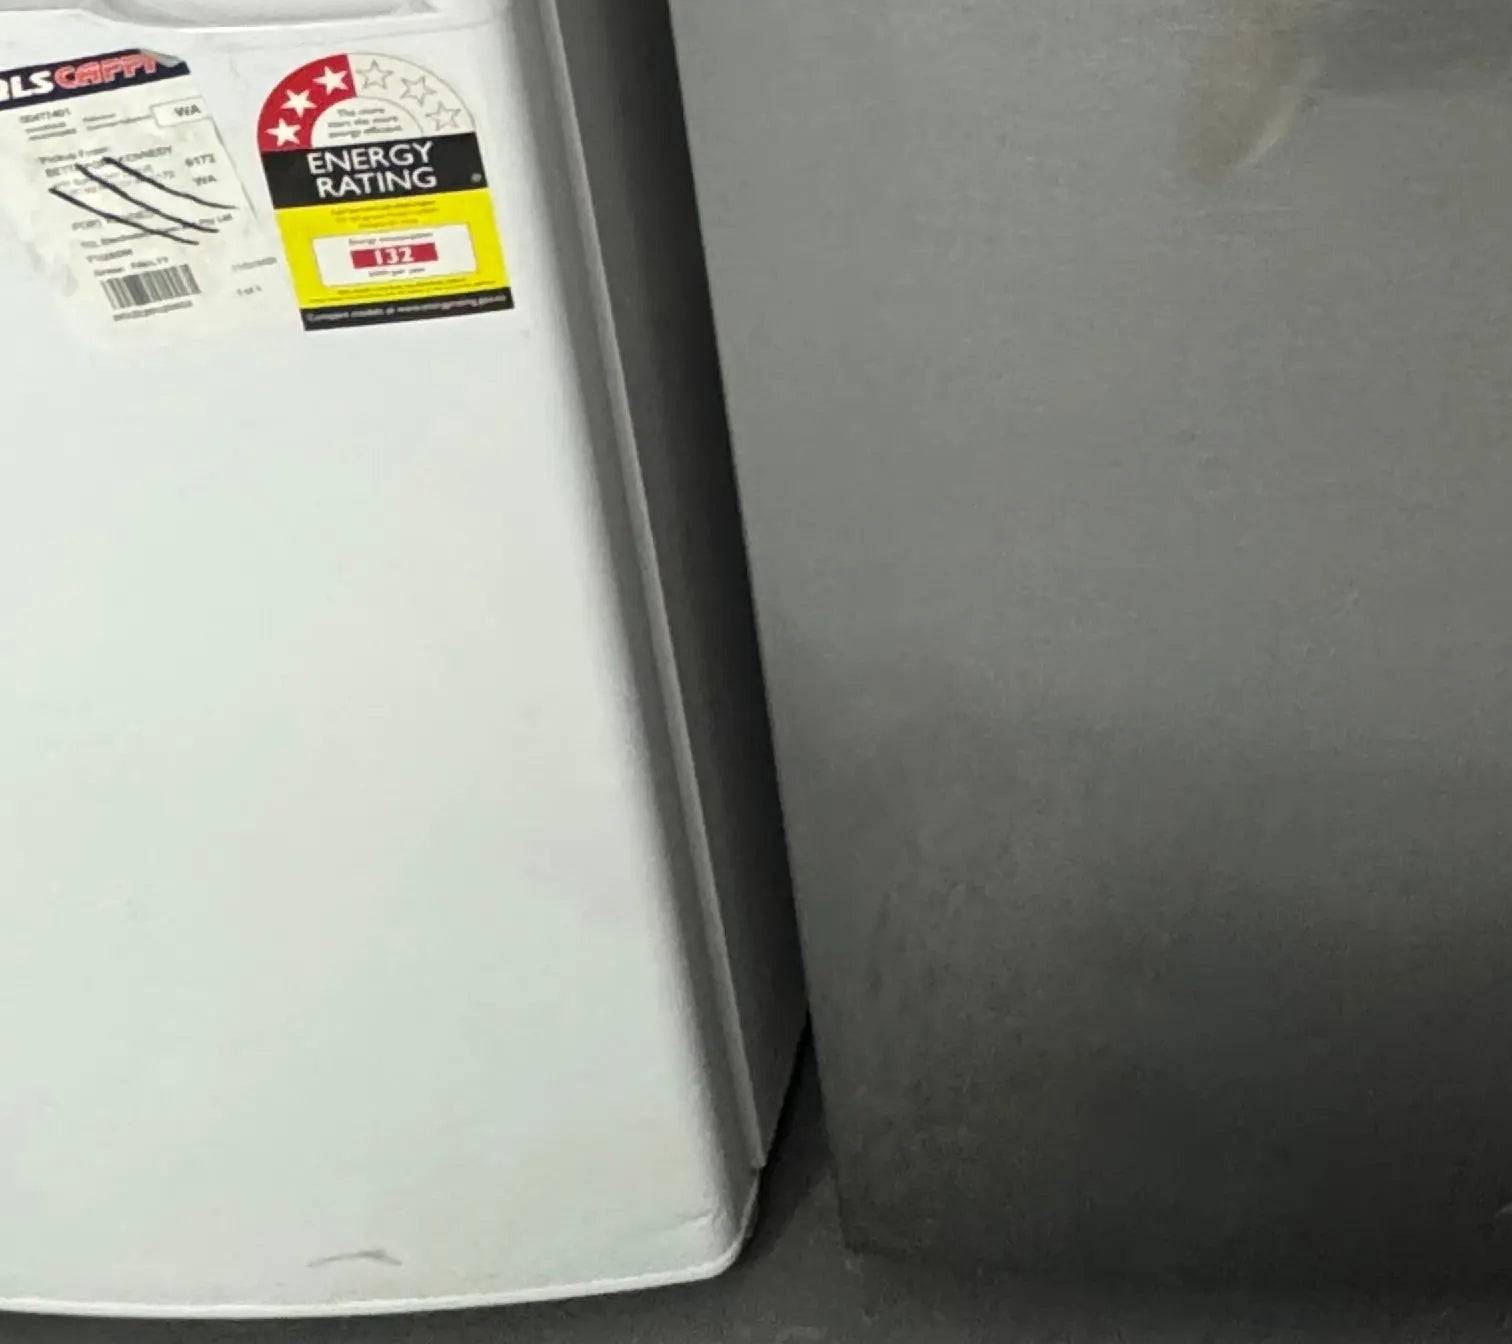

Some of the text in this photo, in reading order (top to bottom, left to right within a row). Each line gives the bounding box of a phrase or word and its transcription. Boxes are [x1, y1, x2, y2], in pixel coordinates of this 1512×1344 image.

[307, 140, 433, 176] ENERGY
[316, 166, 437, 199] RATING
[374, 246, 415, 265] 132
